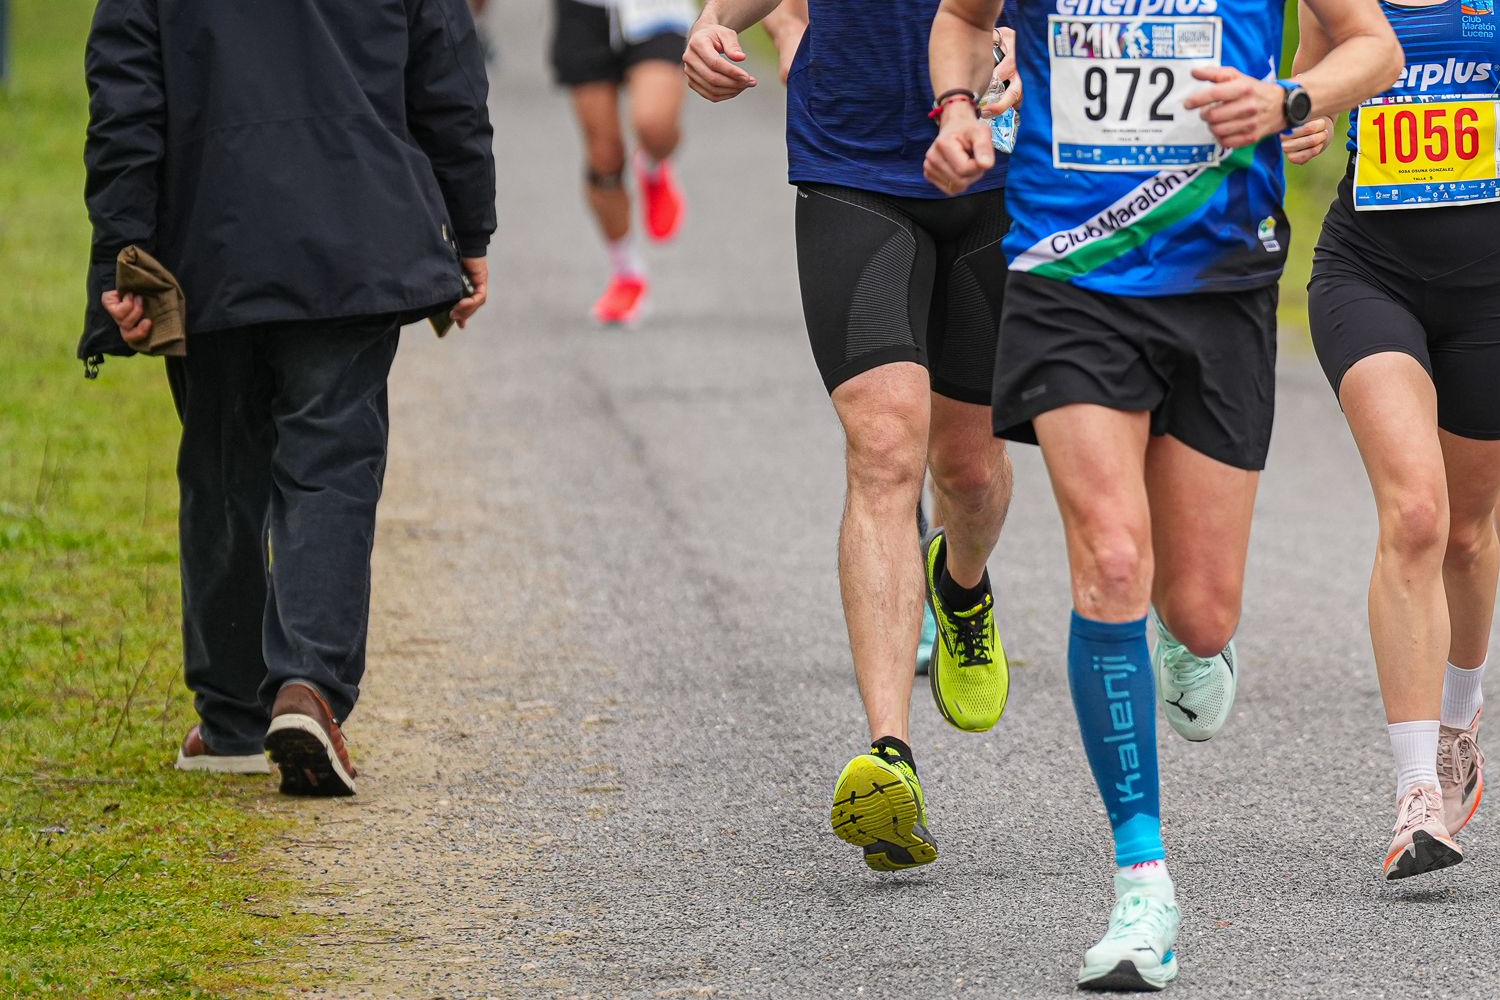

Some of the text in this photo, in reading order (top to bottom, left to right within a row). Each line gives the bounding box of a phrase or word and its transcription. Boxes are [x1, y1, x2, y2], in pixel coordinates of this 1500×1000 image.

[1461, 15, 1482, 23] Club
[1462, 22, 1496, 31] Maratón
[1462, 30, 1494, 38] Lucena
[1070, 22, 1122, 58] 21K
[1392, 58, 1492, 92] erplus
[1084, 66, 1175, 121] 972
[1372, 107, 1480, 164] 1056
[1051, 172, 1181, 254] Club Maratón
